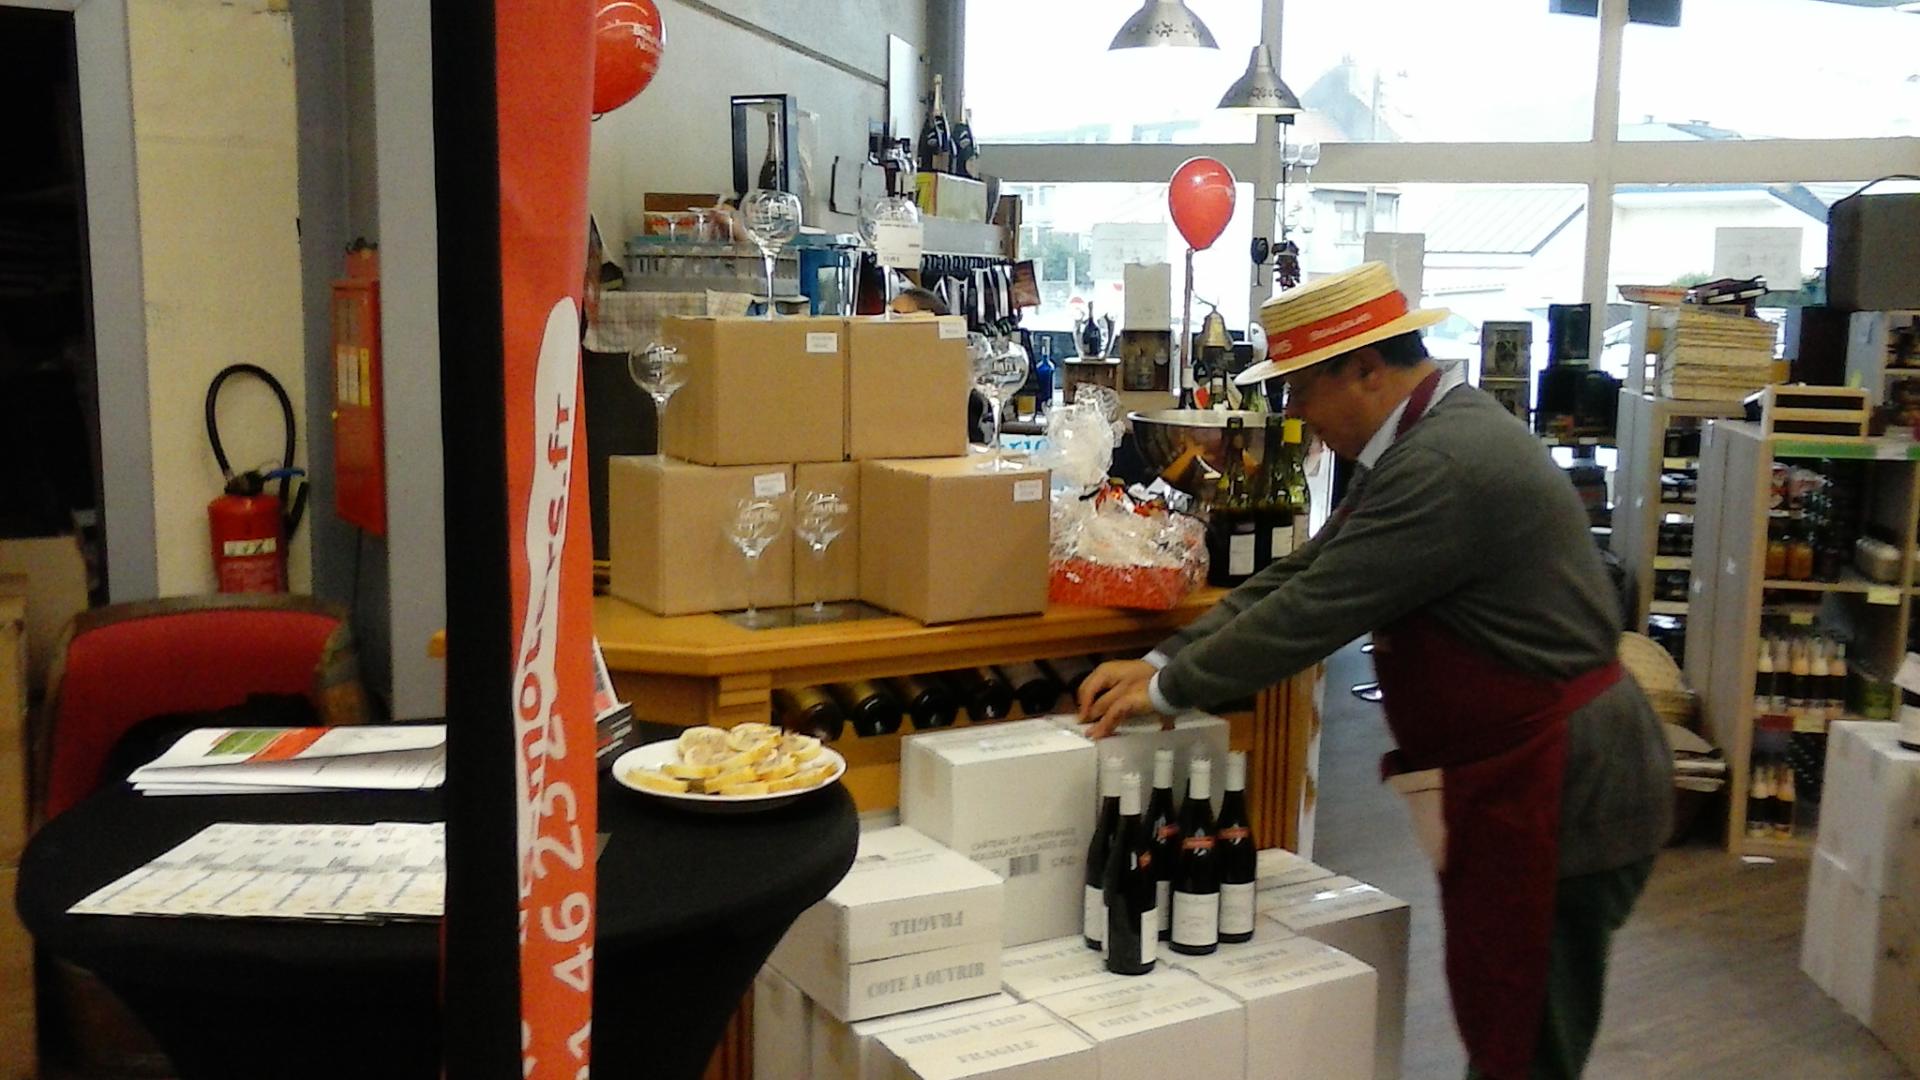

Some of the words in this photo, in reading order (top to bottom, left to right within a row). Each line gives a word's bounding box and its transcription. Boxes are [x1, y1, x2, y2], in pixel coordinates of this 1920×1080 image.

[889, 910, 963, 937] FRAGILE
[541, 890, 593, 992] 46
[925, 961, 985, 985] OUVRIR
